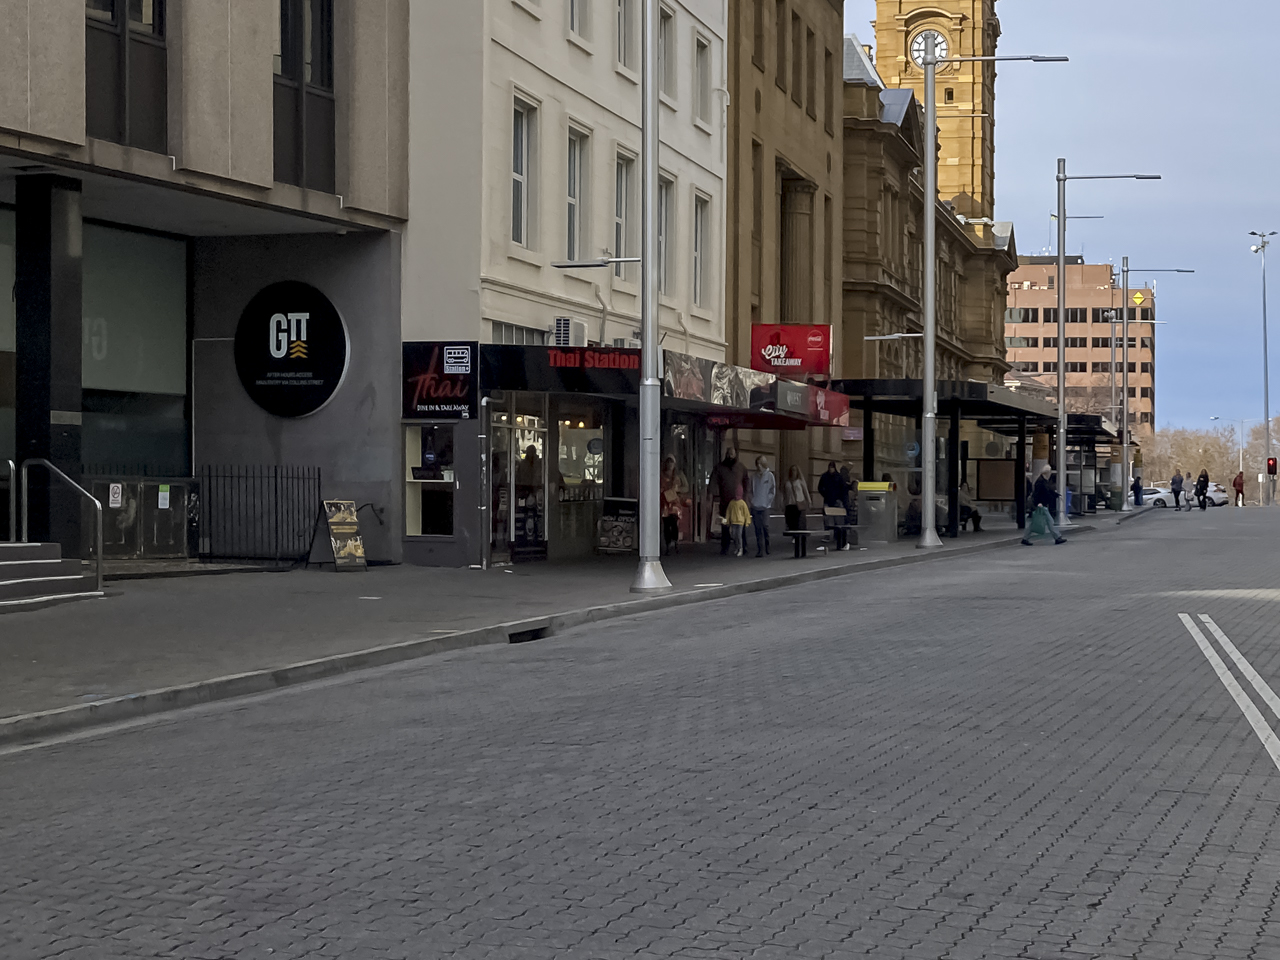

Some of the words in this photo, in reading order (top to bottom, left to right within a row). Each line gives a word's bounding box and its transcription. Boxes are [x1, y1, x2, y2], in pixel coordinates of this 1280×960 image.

[548, 349, 580, 368] Thai
[584, 350, 639, 369] Station
[771, 358, 802, 366] TAKEAWAY
[407, 345, 469, 410] Thai
